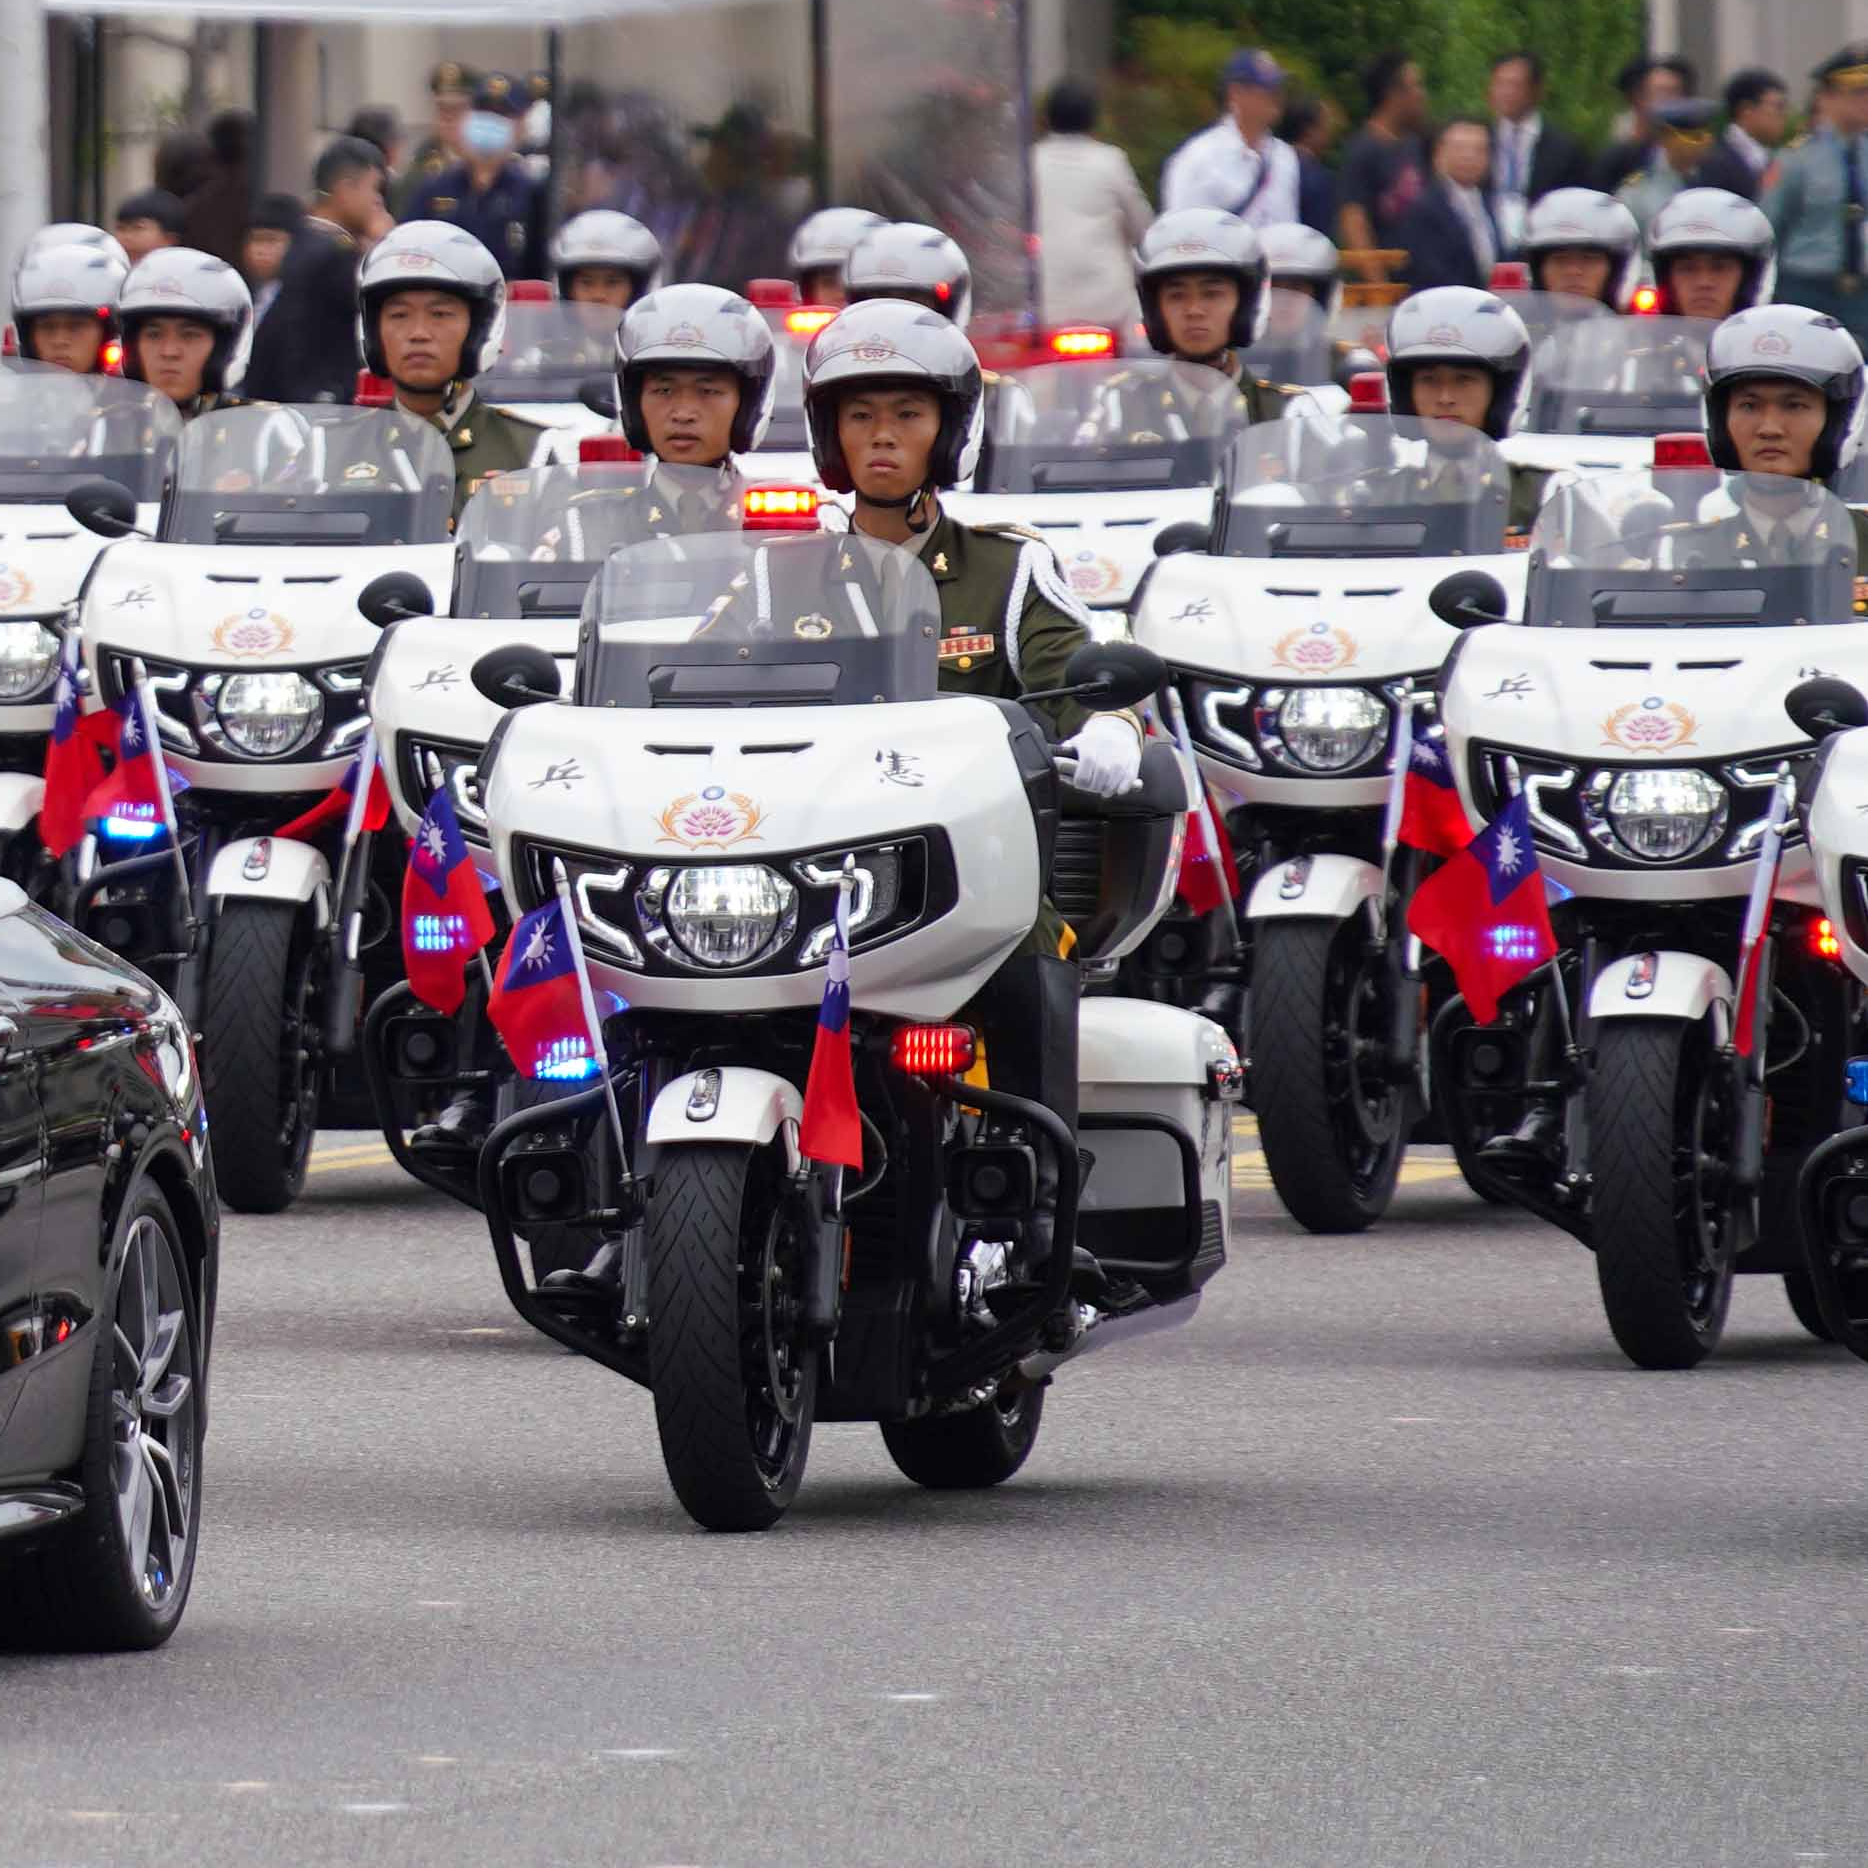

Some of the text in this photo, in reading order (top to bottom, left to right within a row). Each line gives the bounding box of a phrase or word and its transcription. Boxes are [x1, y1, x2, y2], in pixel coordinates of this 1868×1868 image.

[1167, 597, 1219, 624] 兵
[409, 663, 464, 694] 兵
[1481, 672, 1537, 701] 兵
